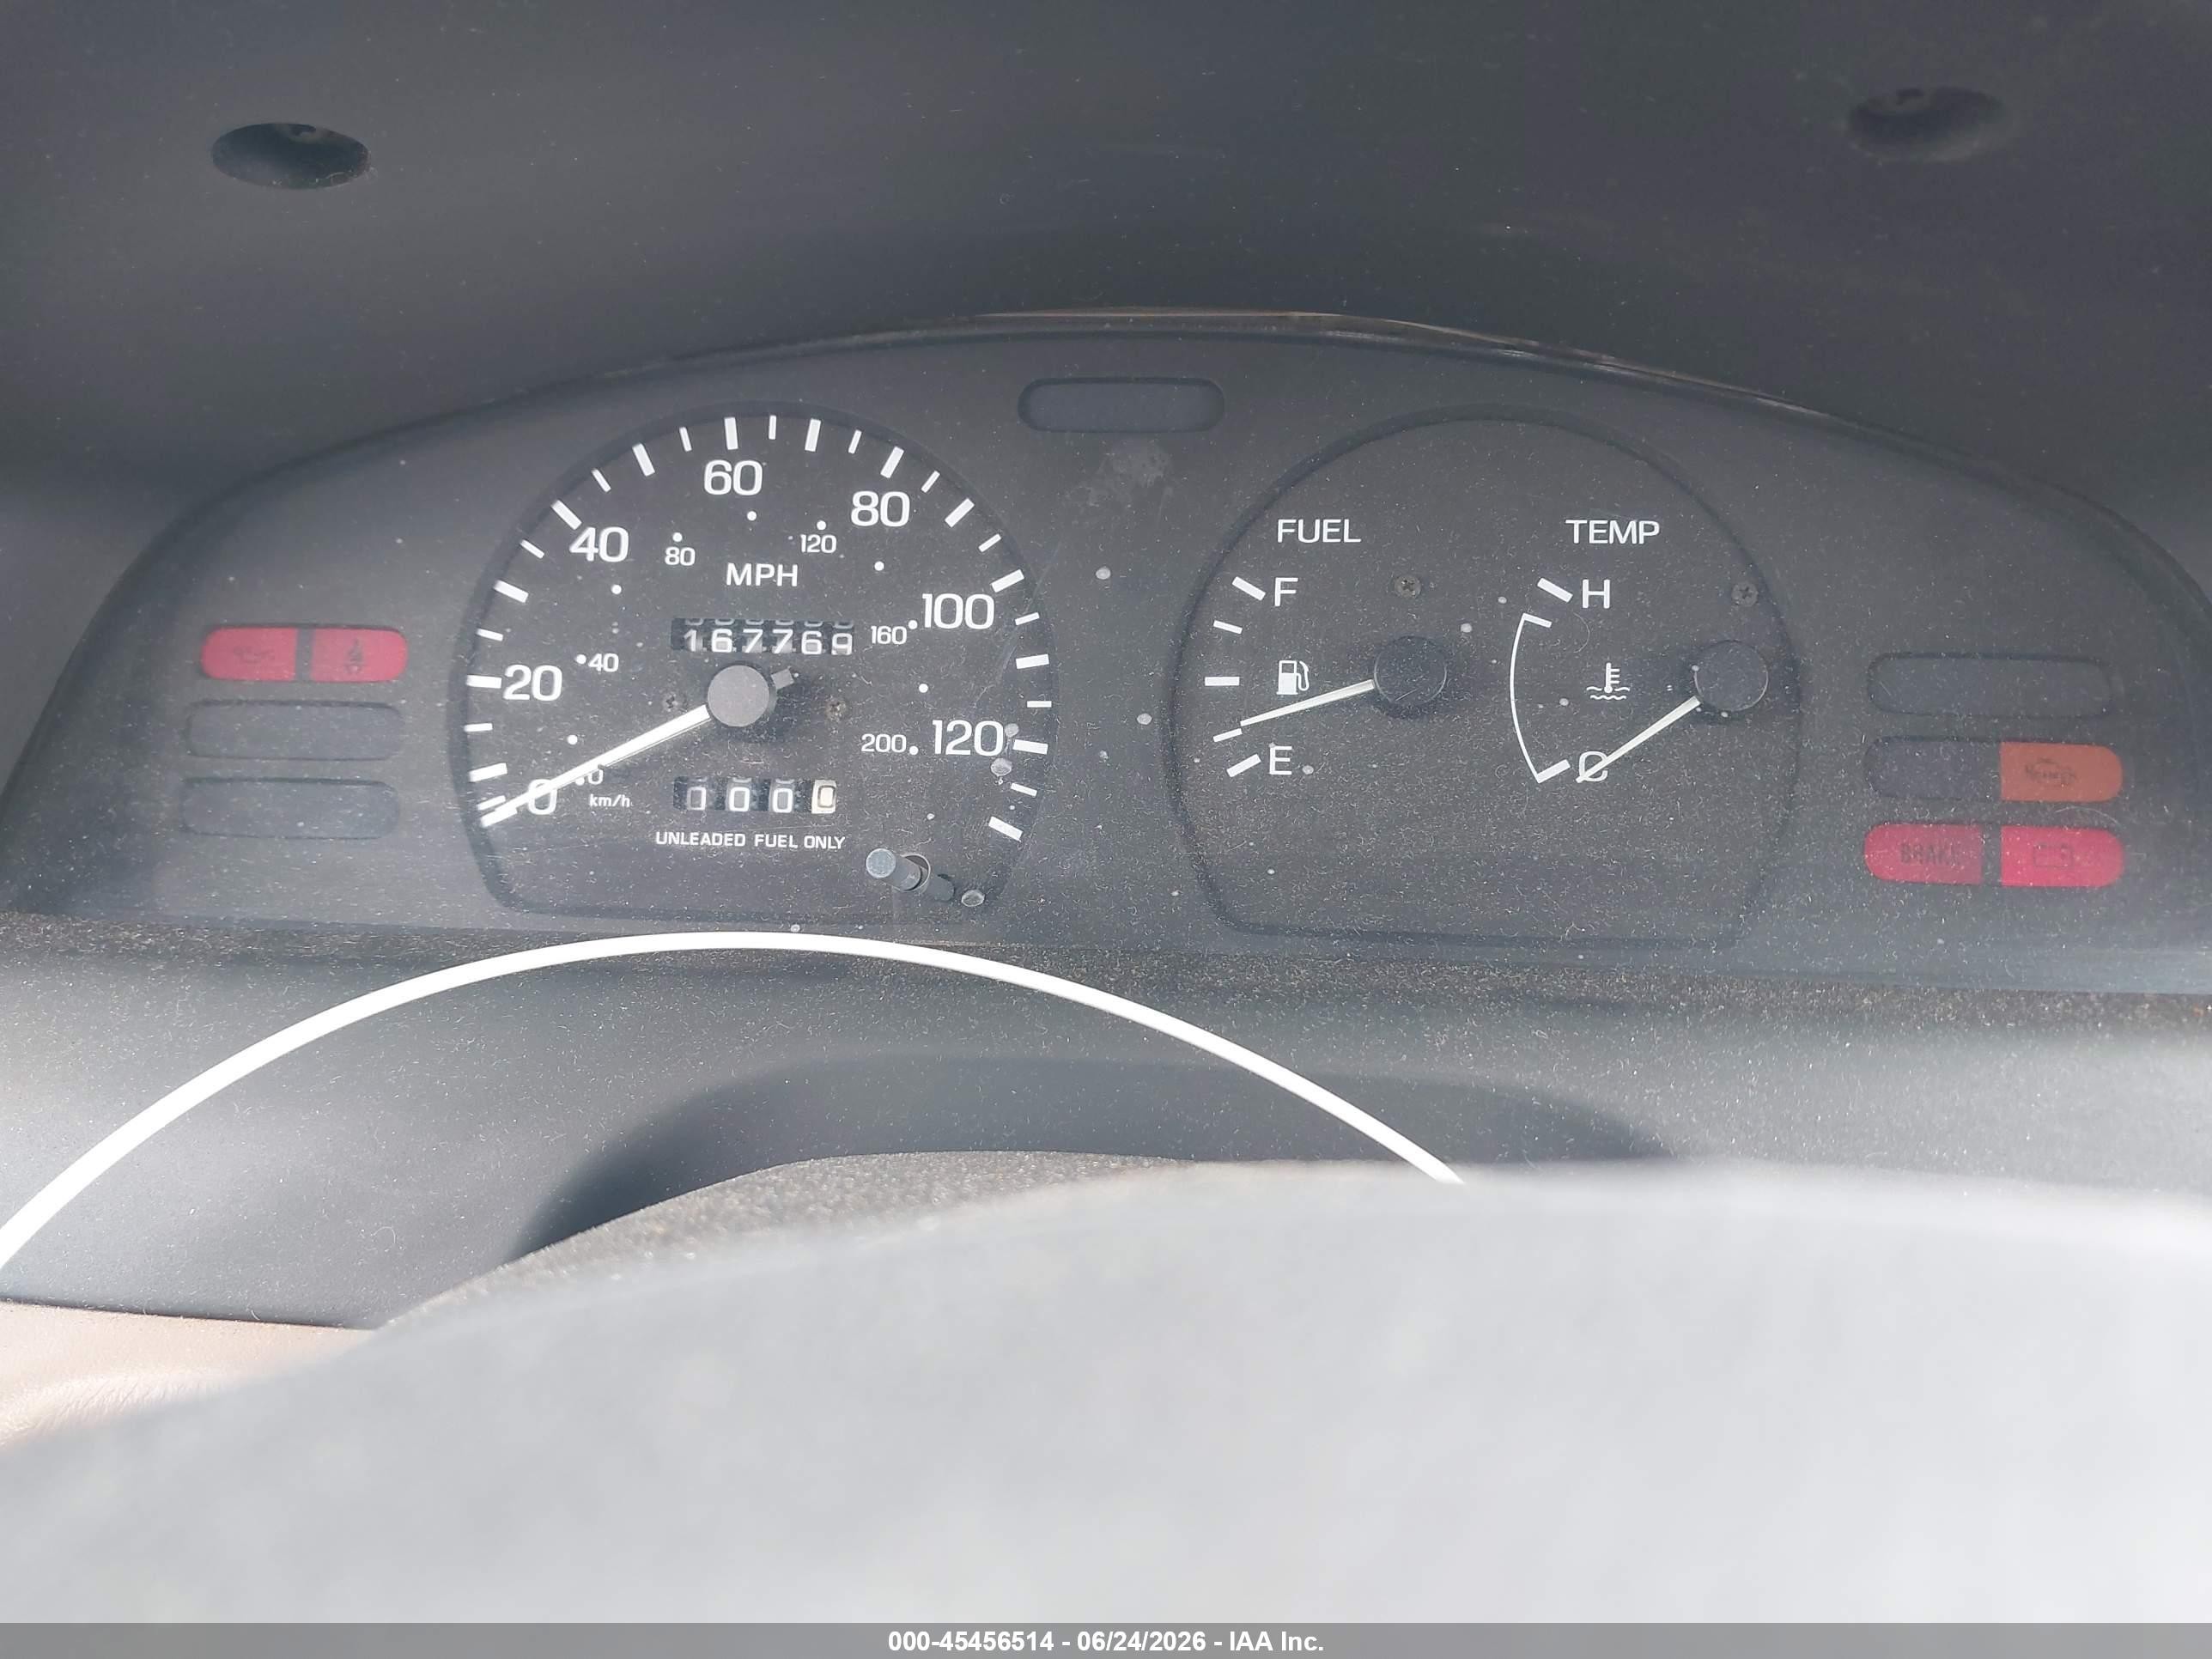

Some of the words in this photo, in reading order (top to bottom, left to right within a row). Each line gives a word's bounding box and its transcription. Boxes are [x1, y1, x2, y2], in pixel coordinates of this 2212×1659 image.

[704, 460, 763, 496] 60
[851, 491, 910, 528] 80
[569, 526, 629, 563] 40
[800, 533, 837, 555] 120
[1277, 519, 1362, 544] FUEL
[1565, 520, 1661, 545] TEMP
[665, 545, 696, 568] 80
[726, 562, 799, 587] MPH
[1273, 576, 1299, 607] F
[1582, 578, 1612, 609] H
[922, 592, 995, 629] 100
[871, 625, 908, 647] 160
[589, 653, 619, 673] 40
[503, 665, 562, 702] 20
[861, 733, 908, 754] 200
[933, 720, 1004, 757] 120
[1269, 744, 1293, 775] E
[1578, 750, 1609, 782] C
[527, 778, 558, 816] 0
[589, 793, 631, 808] km/h
[655, 831, 746, 847] UNLEADED
[754, 834, 799, 848] FUEL
[803, 835, 846, 850] ONLY
